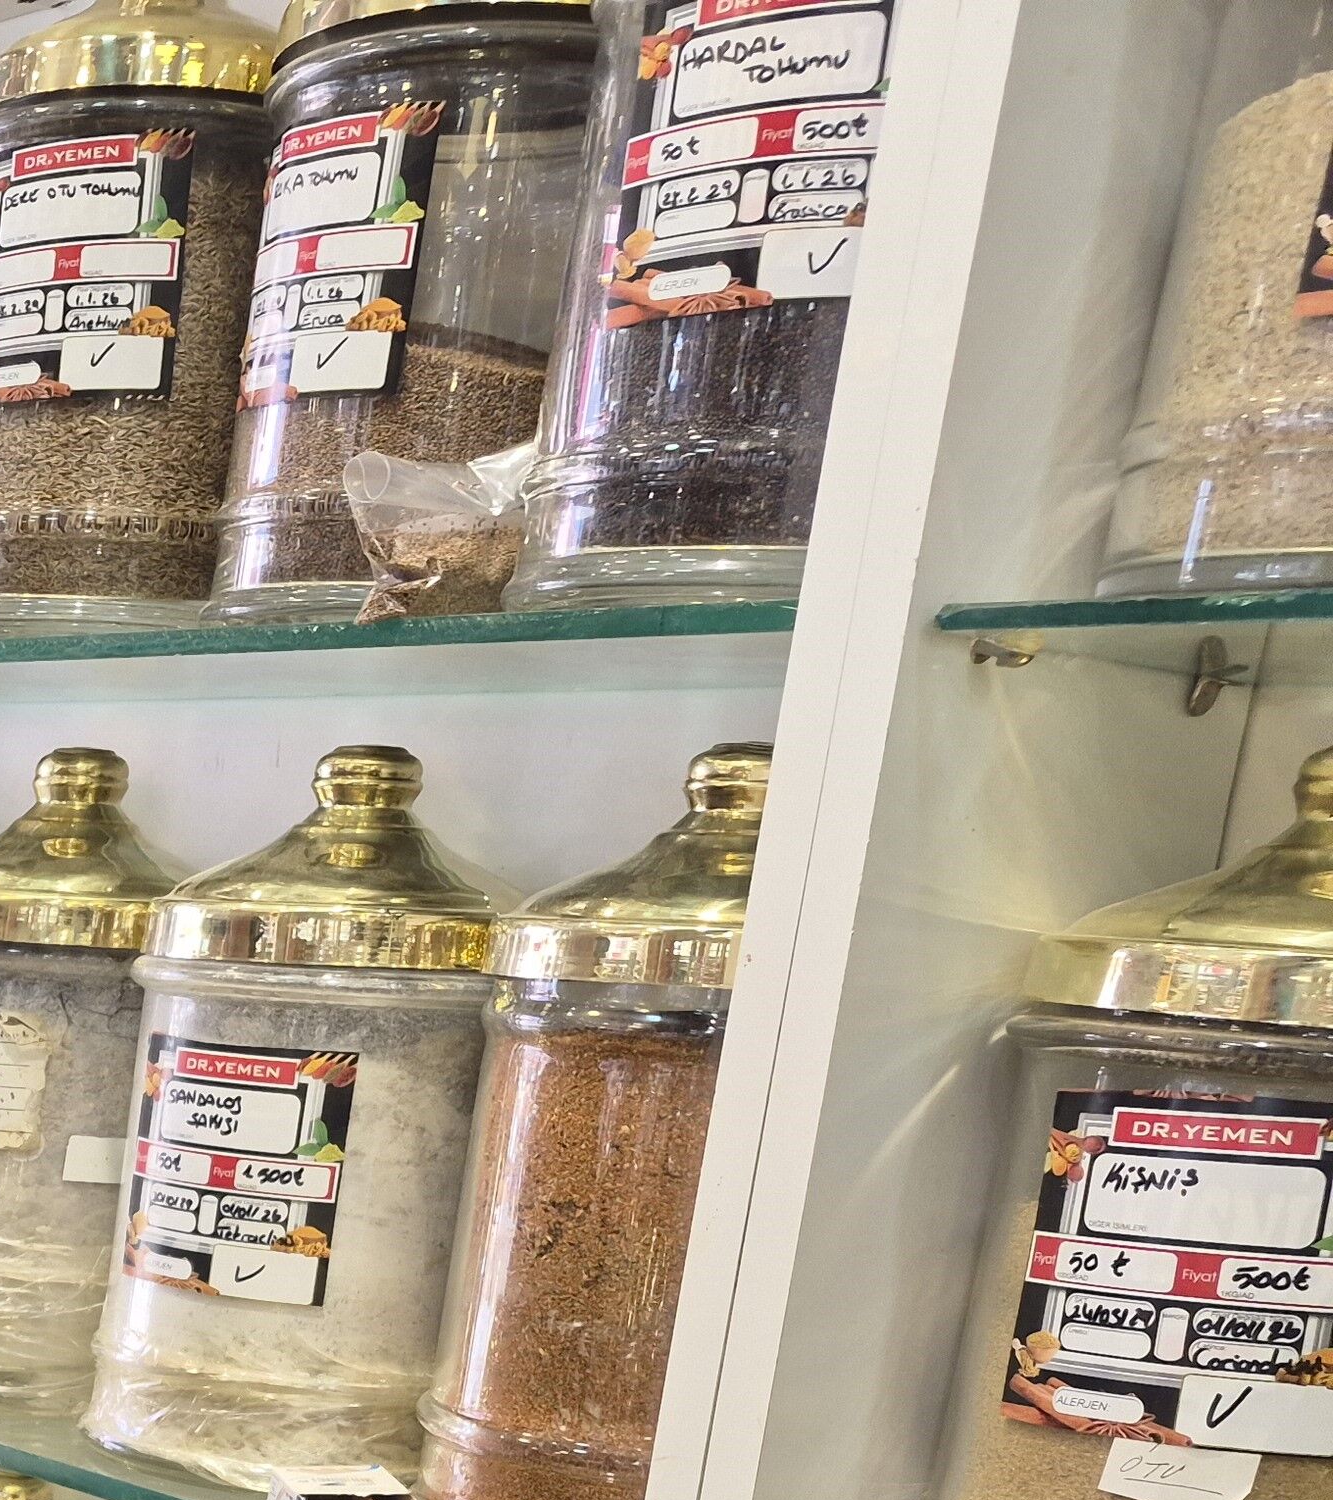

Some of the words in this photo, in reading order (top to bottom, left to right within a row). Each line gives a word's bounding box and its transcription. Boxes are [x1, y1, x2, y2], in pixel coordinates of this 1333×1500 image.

[682, 35, 786, 71] HARDAL
[742, 50, 851, 83] TOHUMU
[23, 144, 120, 170] DR.YEMEN
[186, 1057, 281, 1079] DR.YEMEN
[1132, 1119, 1294, 1147] DR.YEMEN
[1182, 1268, 1218, 1284] Fiyat
